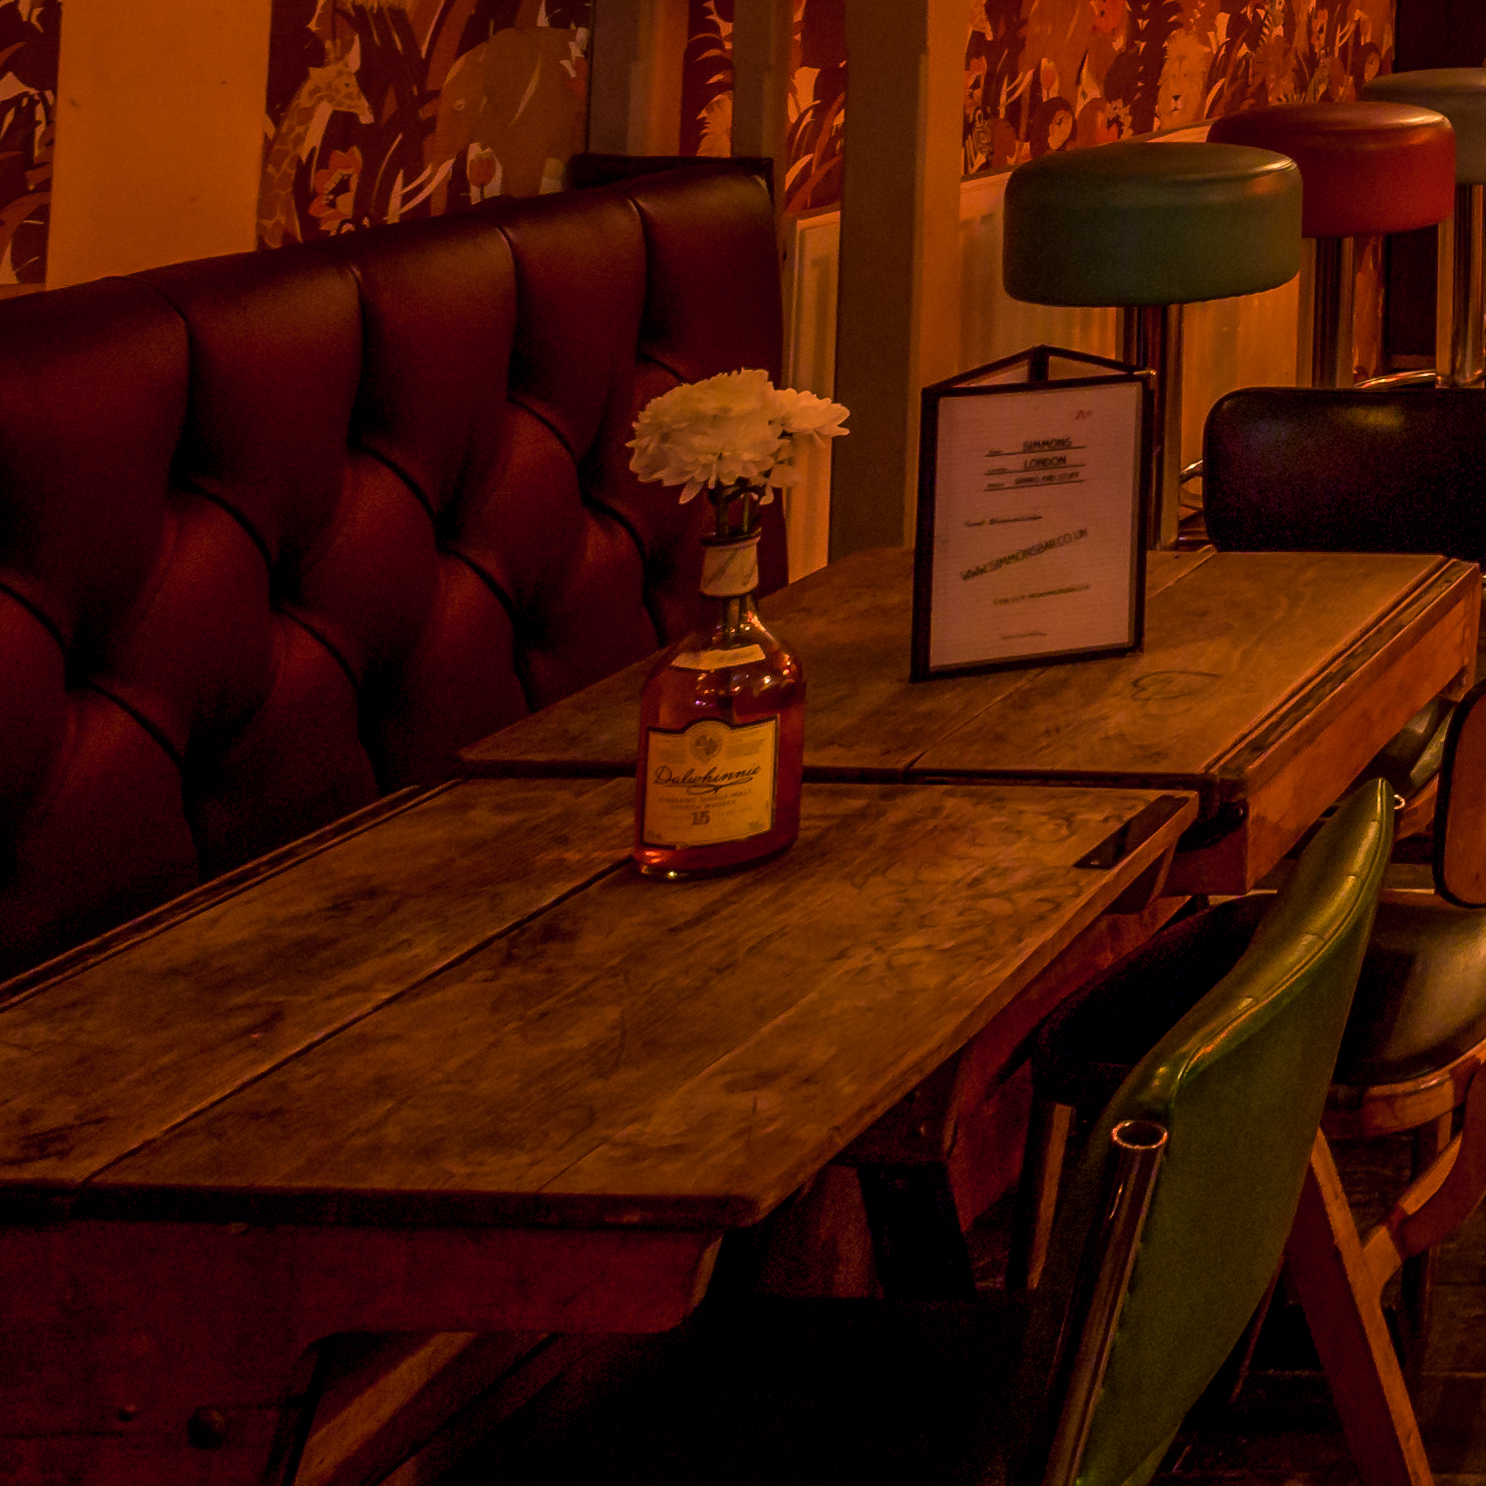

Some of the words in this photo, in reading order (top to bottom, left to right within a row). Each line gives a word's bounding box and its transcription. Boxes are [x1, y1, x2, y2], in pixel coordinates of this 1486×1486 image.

[1022, 436, 1073, 453] SIMMONS
[1023, 455, 1067, 470] LONDON
[653, 764, 761, 789] Dalwhinnie
[691, 810, 711, 826] 15
